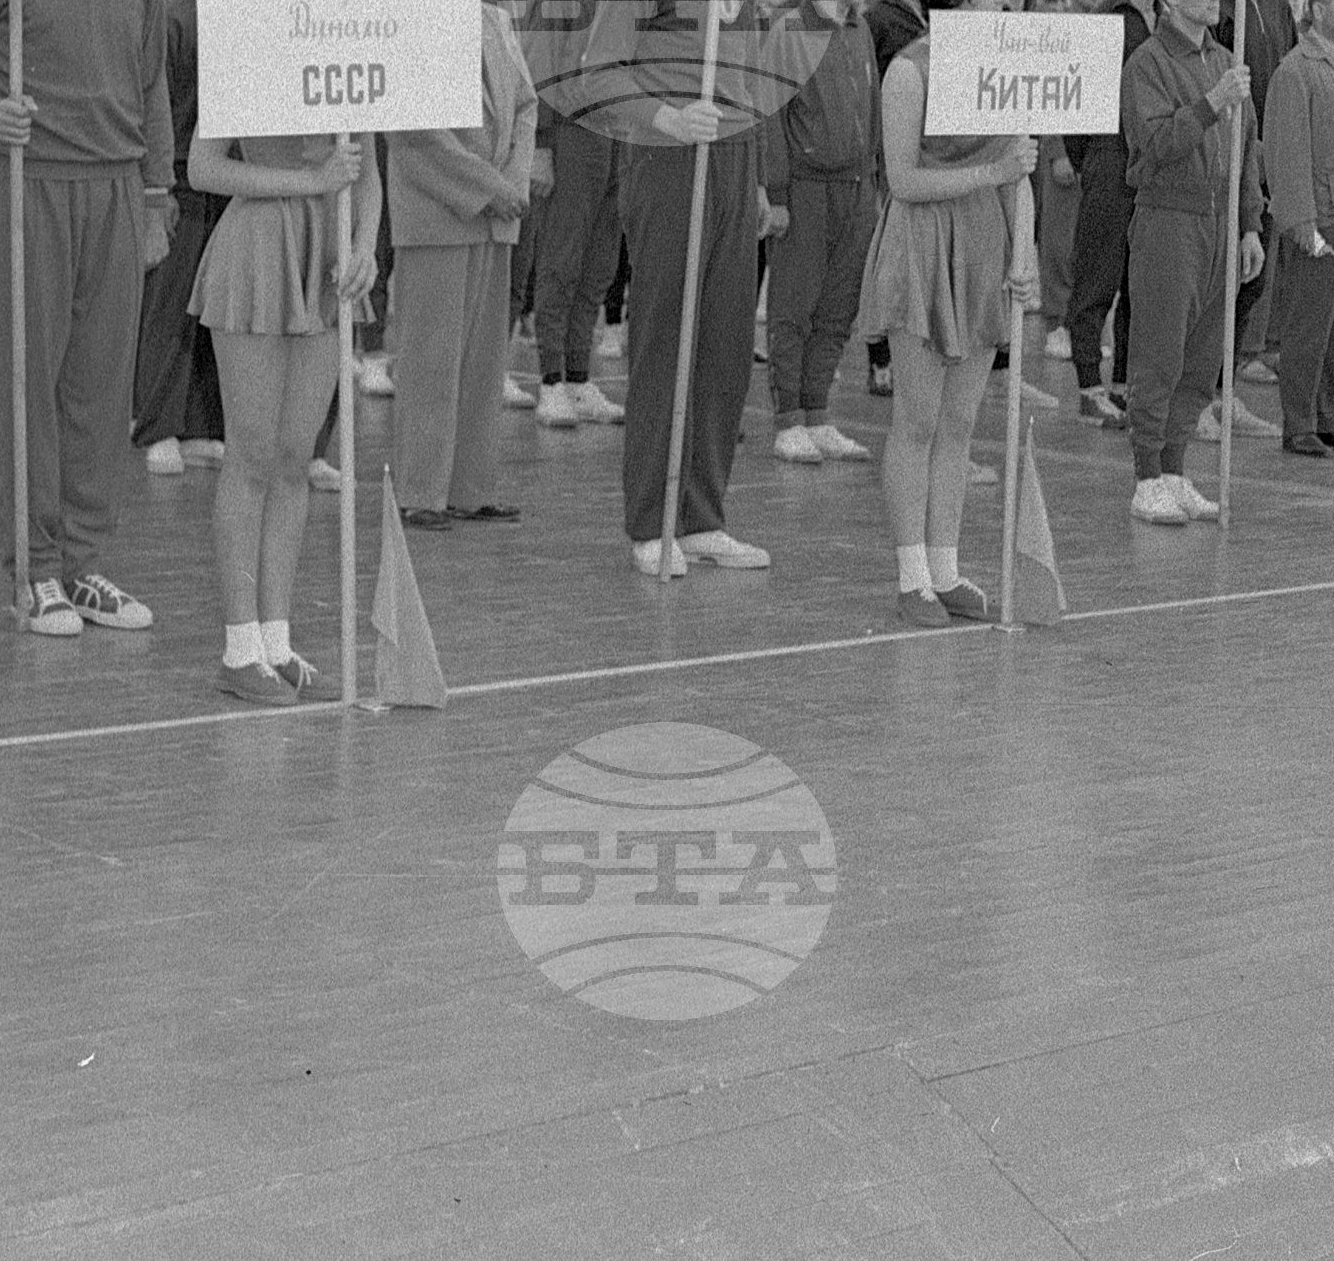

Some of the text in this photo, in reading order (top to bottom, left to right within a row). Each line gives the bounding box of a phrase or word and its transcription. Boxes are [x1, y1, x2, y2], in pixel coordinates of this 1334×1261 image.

[288, 1, 399, 39] Динамо
[301, 63, 386, 106] СССР
[976, 62, 1083, 111] КИТАЙ
